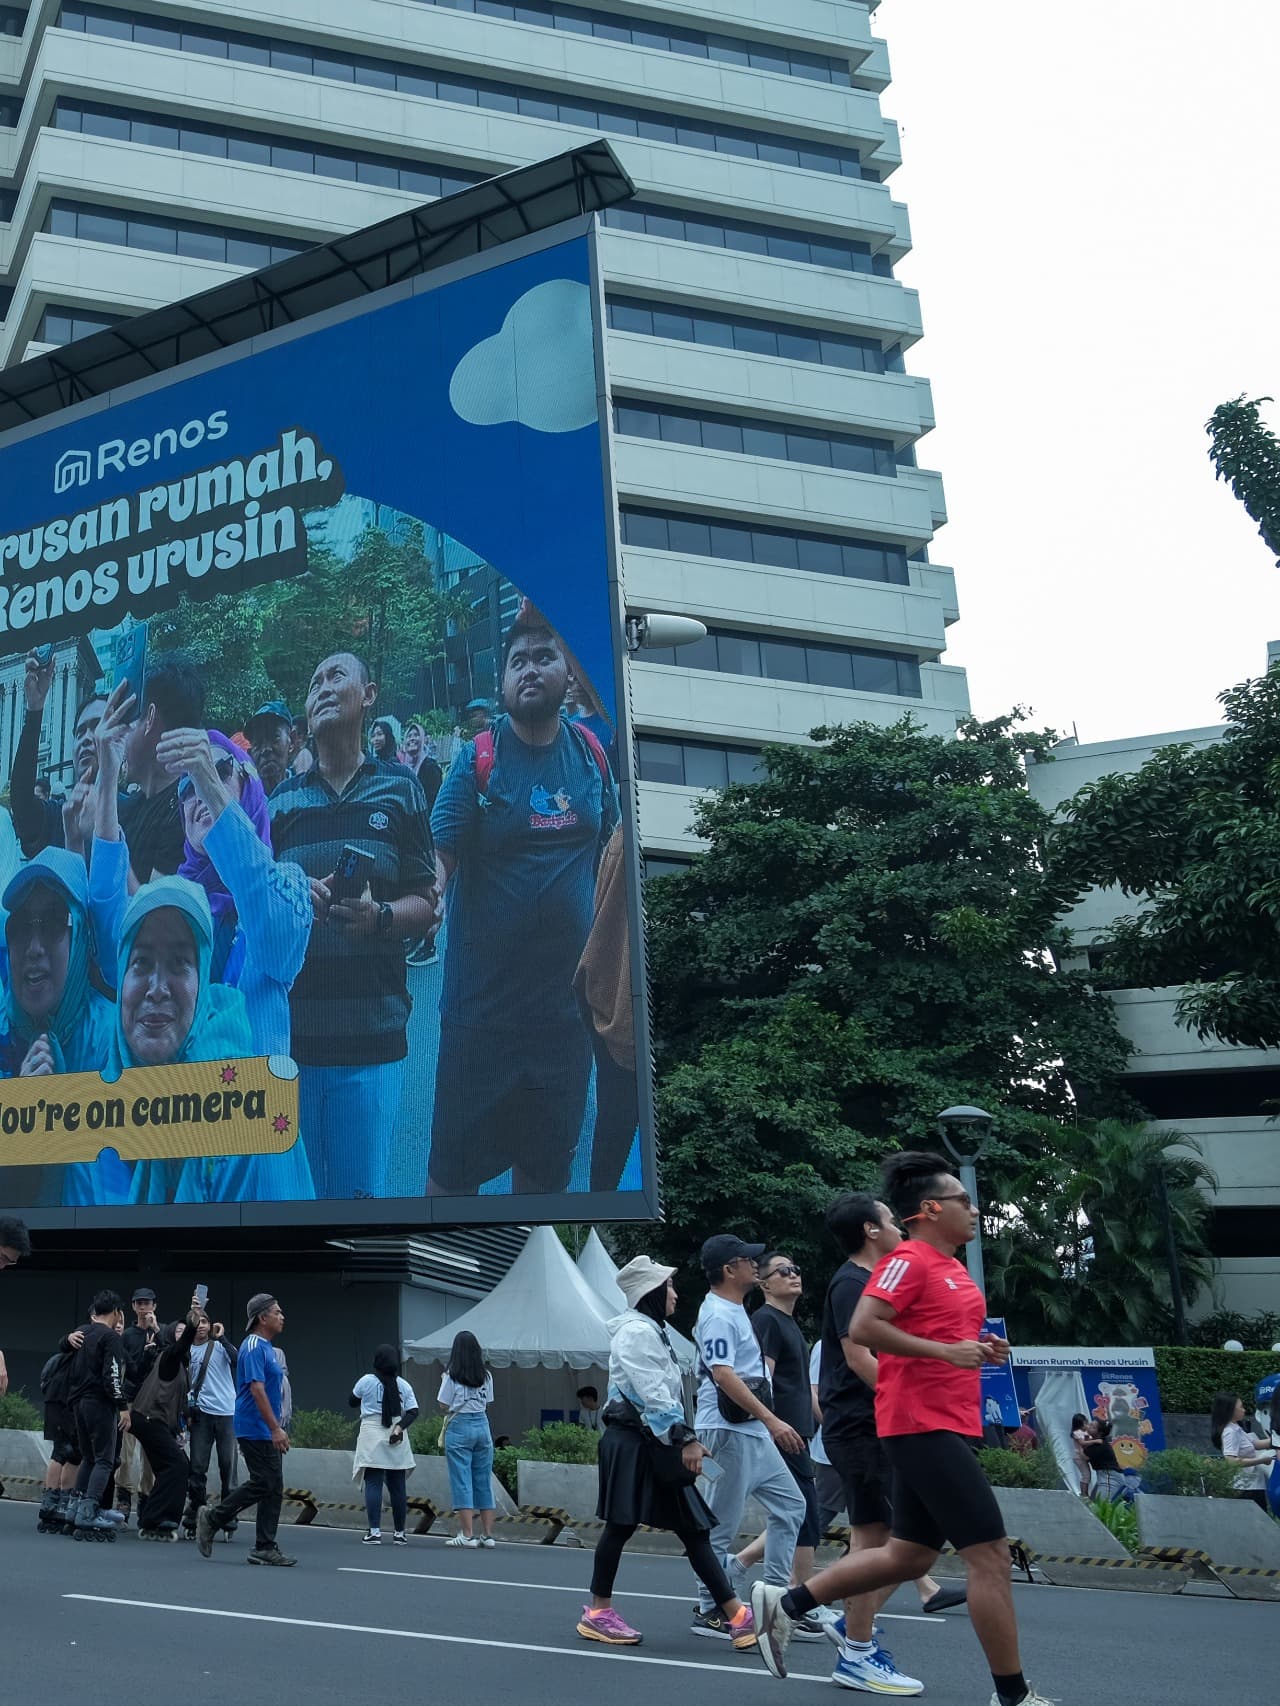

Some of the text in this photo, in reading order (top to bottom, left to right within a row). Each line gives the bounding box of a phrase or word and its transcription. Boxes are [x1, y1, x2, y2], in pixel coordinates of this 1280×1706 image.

[96, 409, 229, 480] Renos
[136, 429, 334, 532] rumah,
[126, 501, 297, 594] urusin
[86, 1099, 126, 1130] on
[131, 1088, 267, 1126] camera
[704, 1338, 728, 1361] 30
[1016, 1357, 1149, 1367] Urusan Rumah, Renos Urusin
